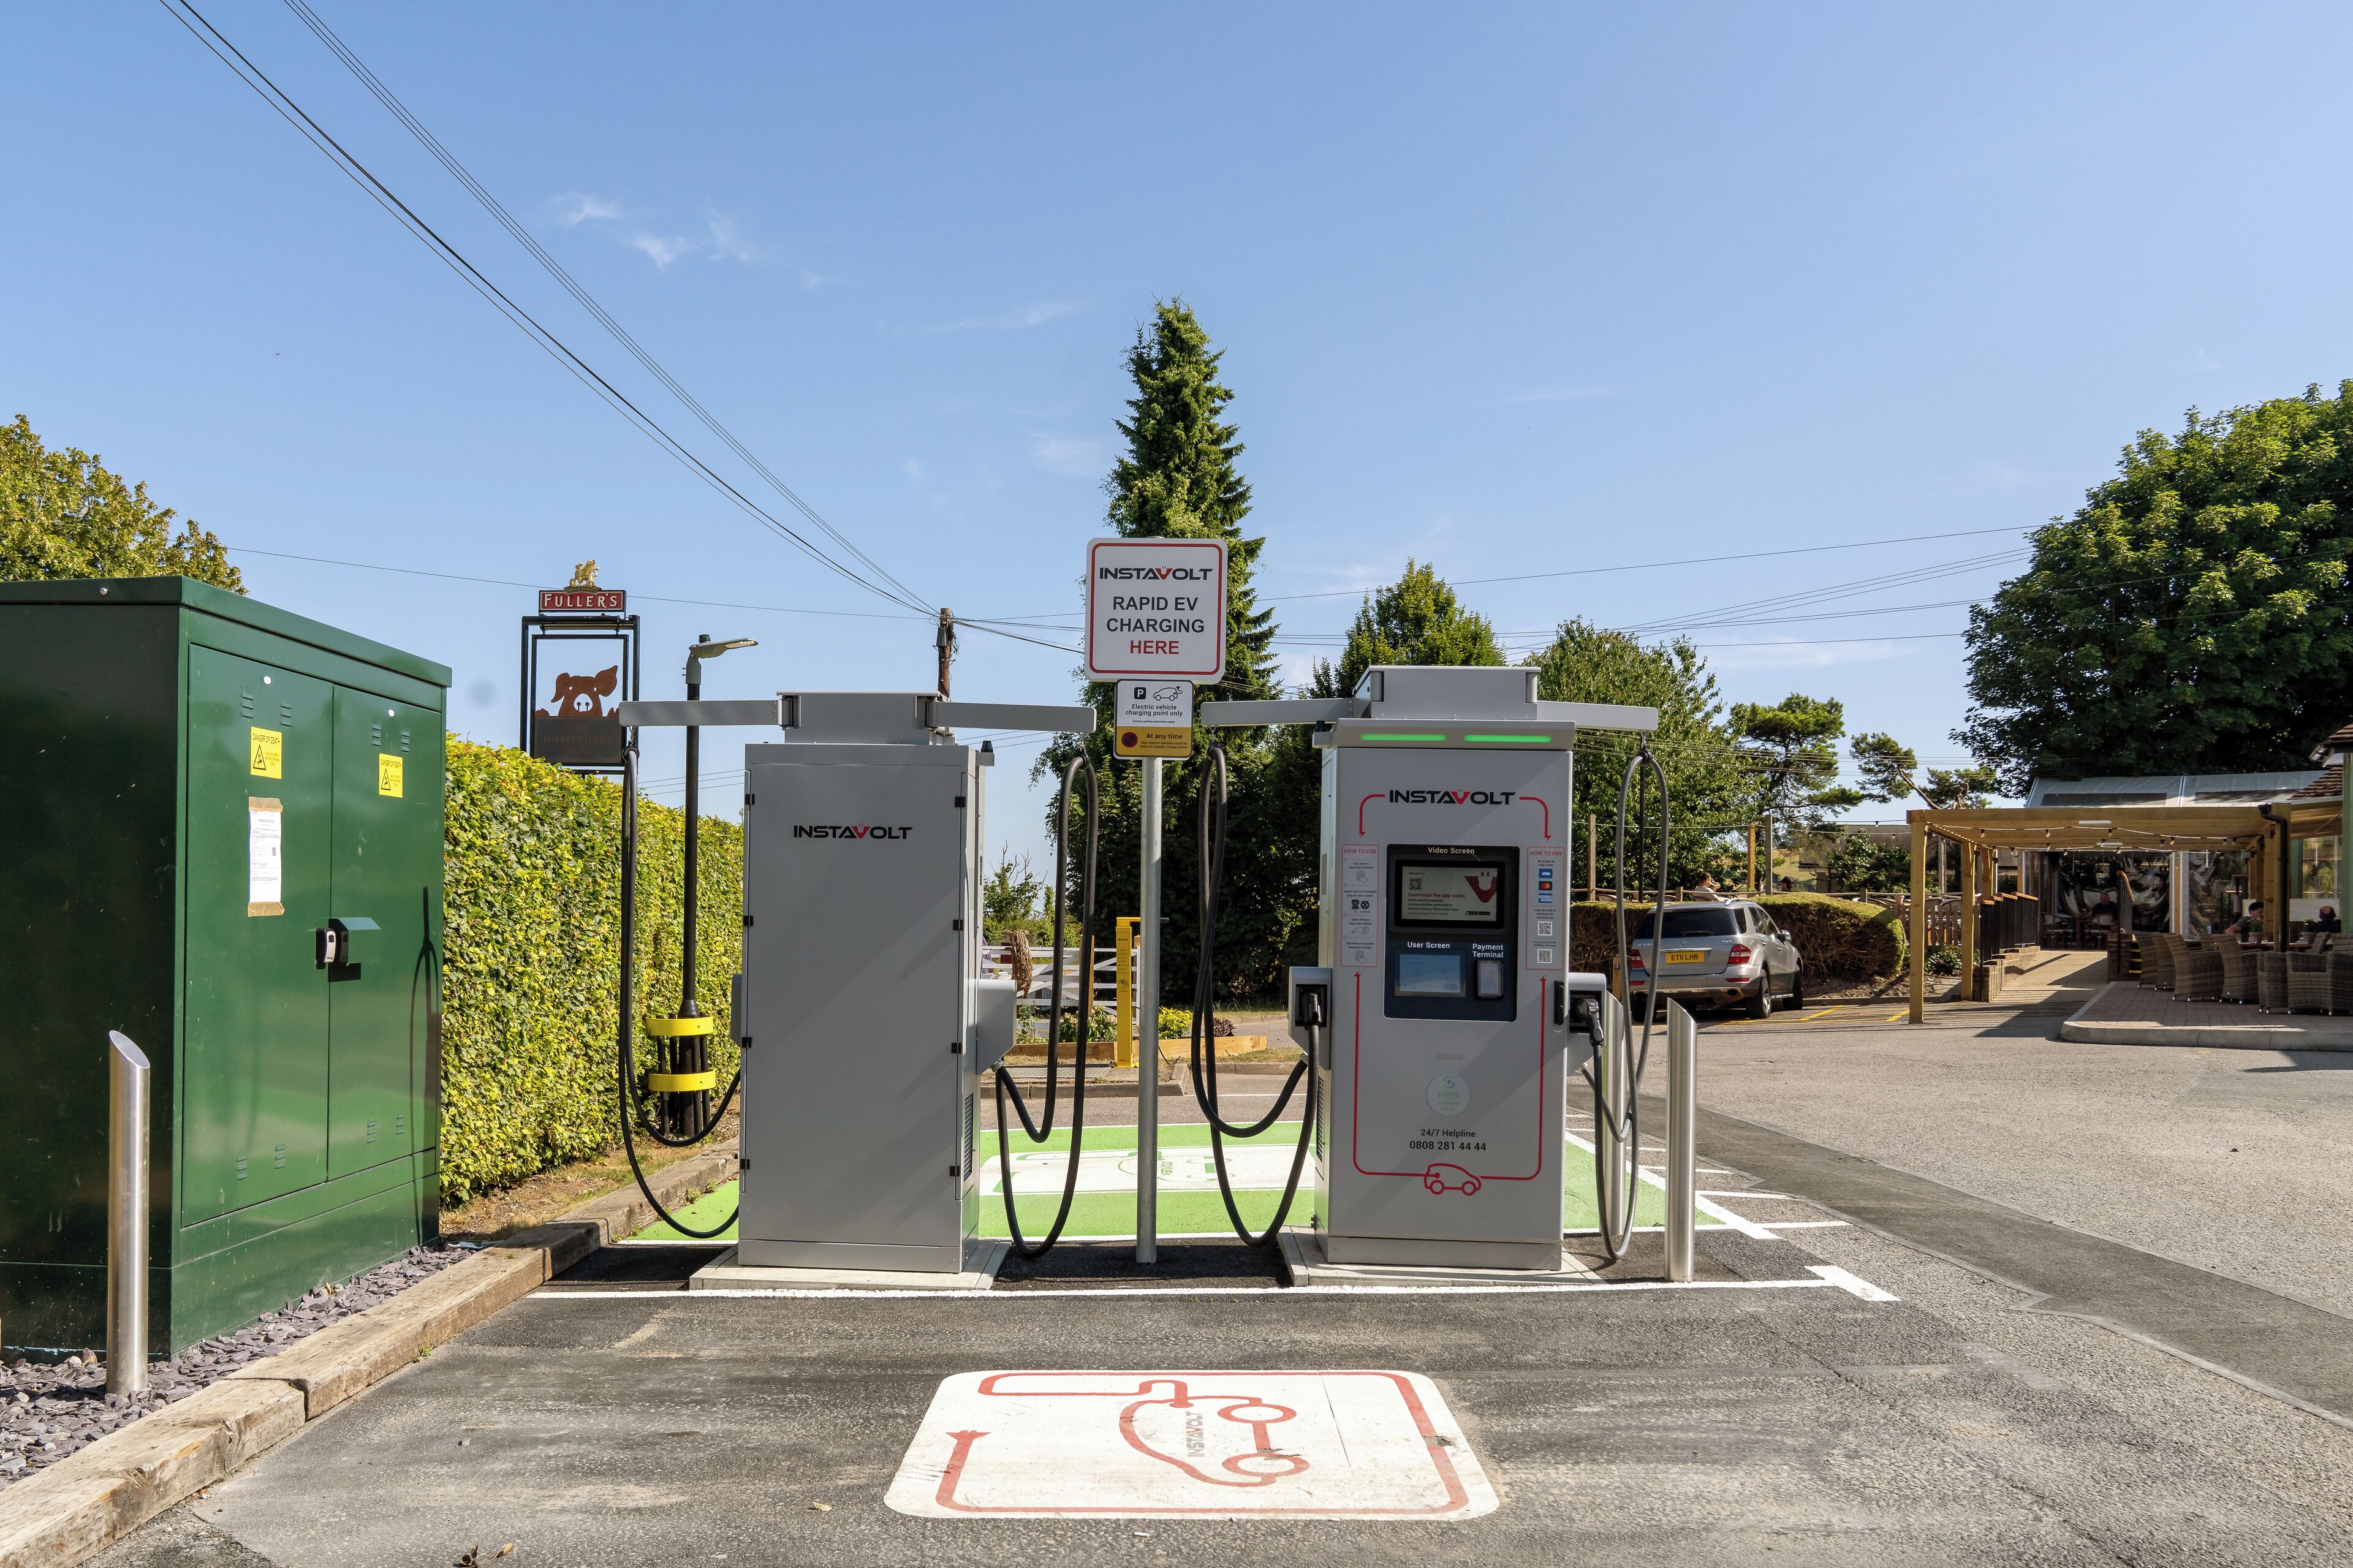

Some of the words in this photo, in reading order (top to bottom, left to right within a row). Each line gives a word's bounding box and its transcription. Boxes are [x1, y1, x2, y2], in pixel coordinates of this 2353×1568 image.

[1099, 566, 1213, 580] INSTAVOLT
[544, 593, 618, 608] FULLER'S
[1113, 596, 1169, 610] RAPID
[1174, 597, 1199, 610] EV
[1107, 618, 1205, 633] CHARGING
[1130, 640, 1179, 654] HERE
[1389, 789, 1516, 805] INSTAVOLT
[794, 824, 913, 839] INSTAVOLT
[1438, 1091, 1460, 1100] 100%
[1442, 1129, 1476, 1138] Helpline
[1409, 1140, 1434, 1149] 0808
[1474, 1142, 1487, 1151] 44
[1186, 1411, 1205, 1457] INSTAVOLT
